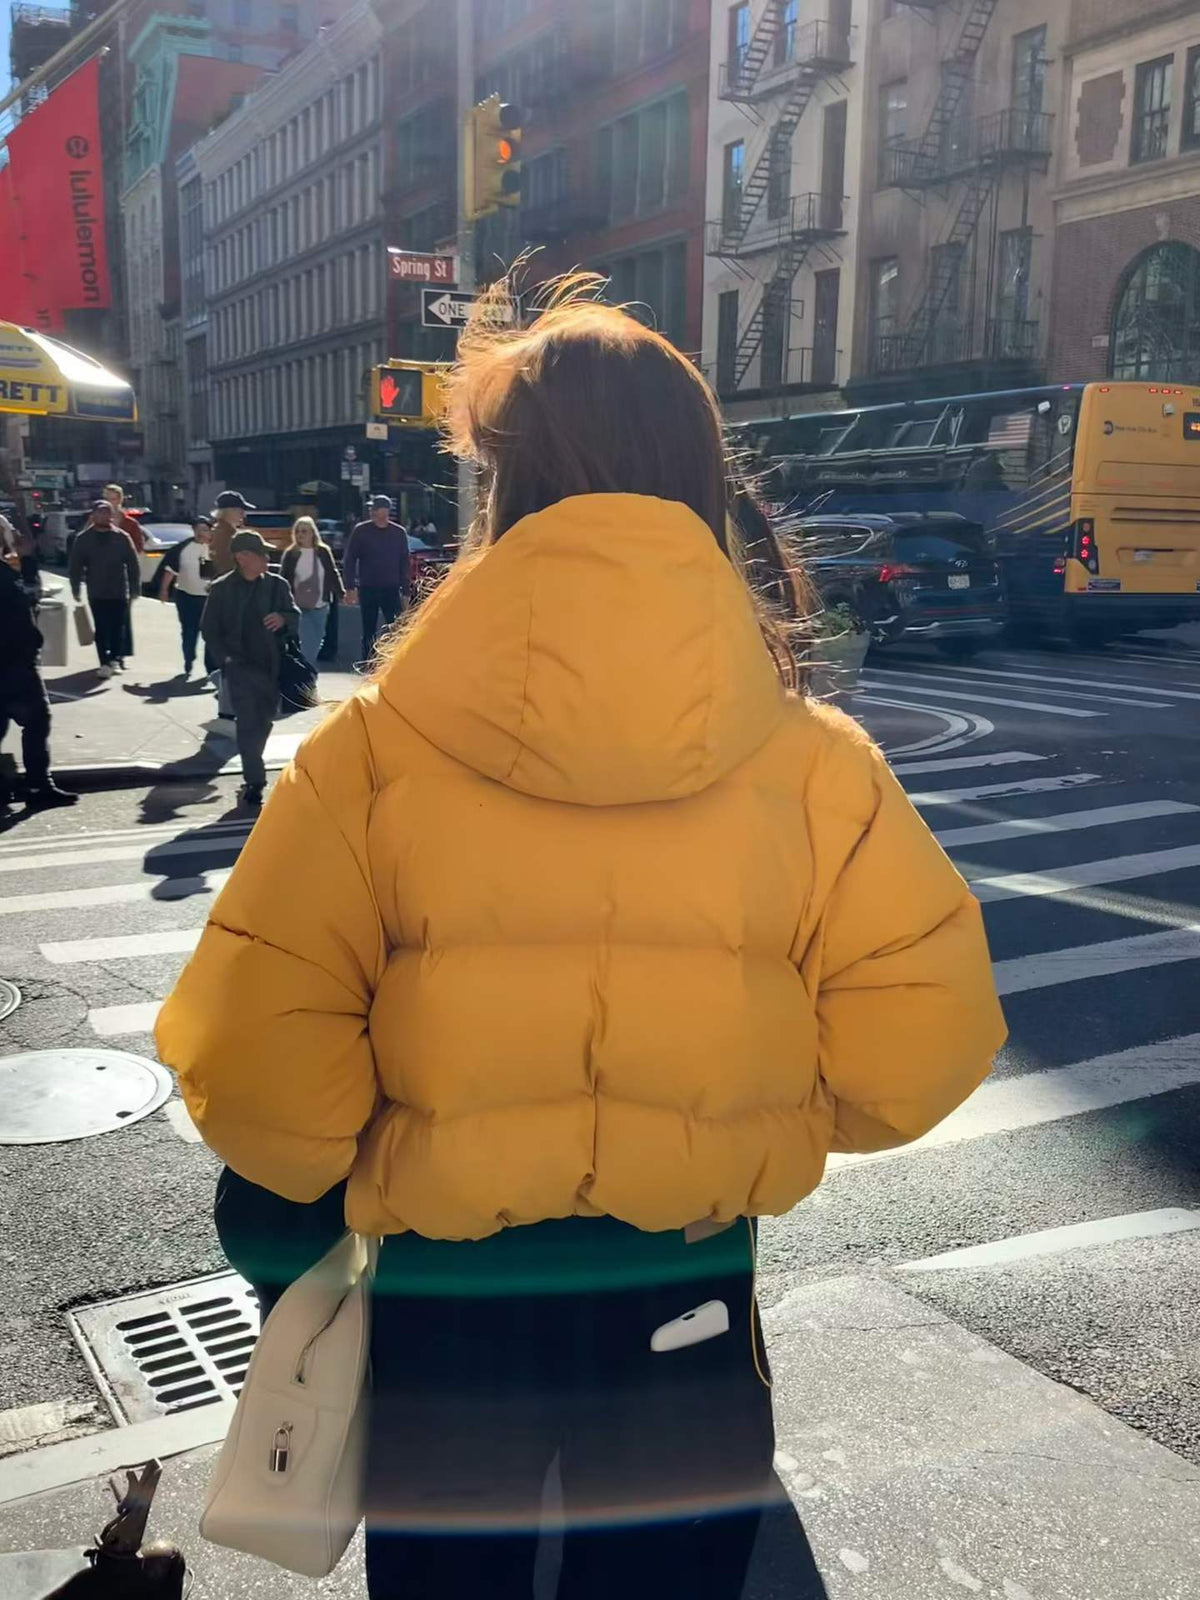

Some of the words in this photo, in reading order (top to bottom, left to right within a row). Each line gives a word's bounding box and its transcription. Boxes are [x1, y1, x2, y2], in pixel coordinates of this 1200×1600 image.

[69, 170, 100, 302] lululemon
[393, 256, 430, 281] Spring
[434, 260, 447, 277] St
[439, 302, 465, 317] ONE
[483, 305, 507, 319] AY
